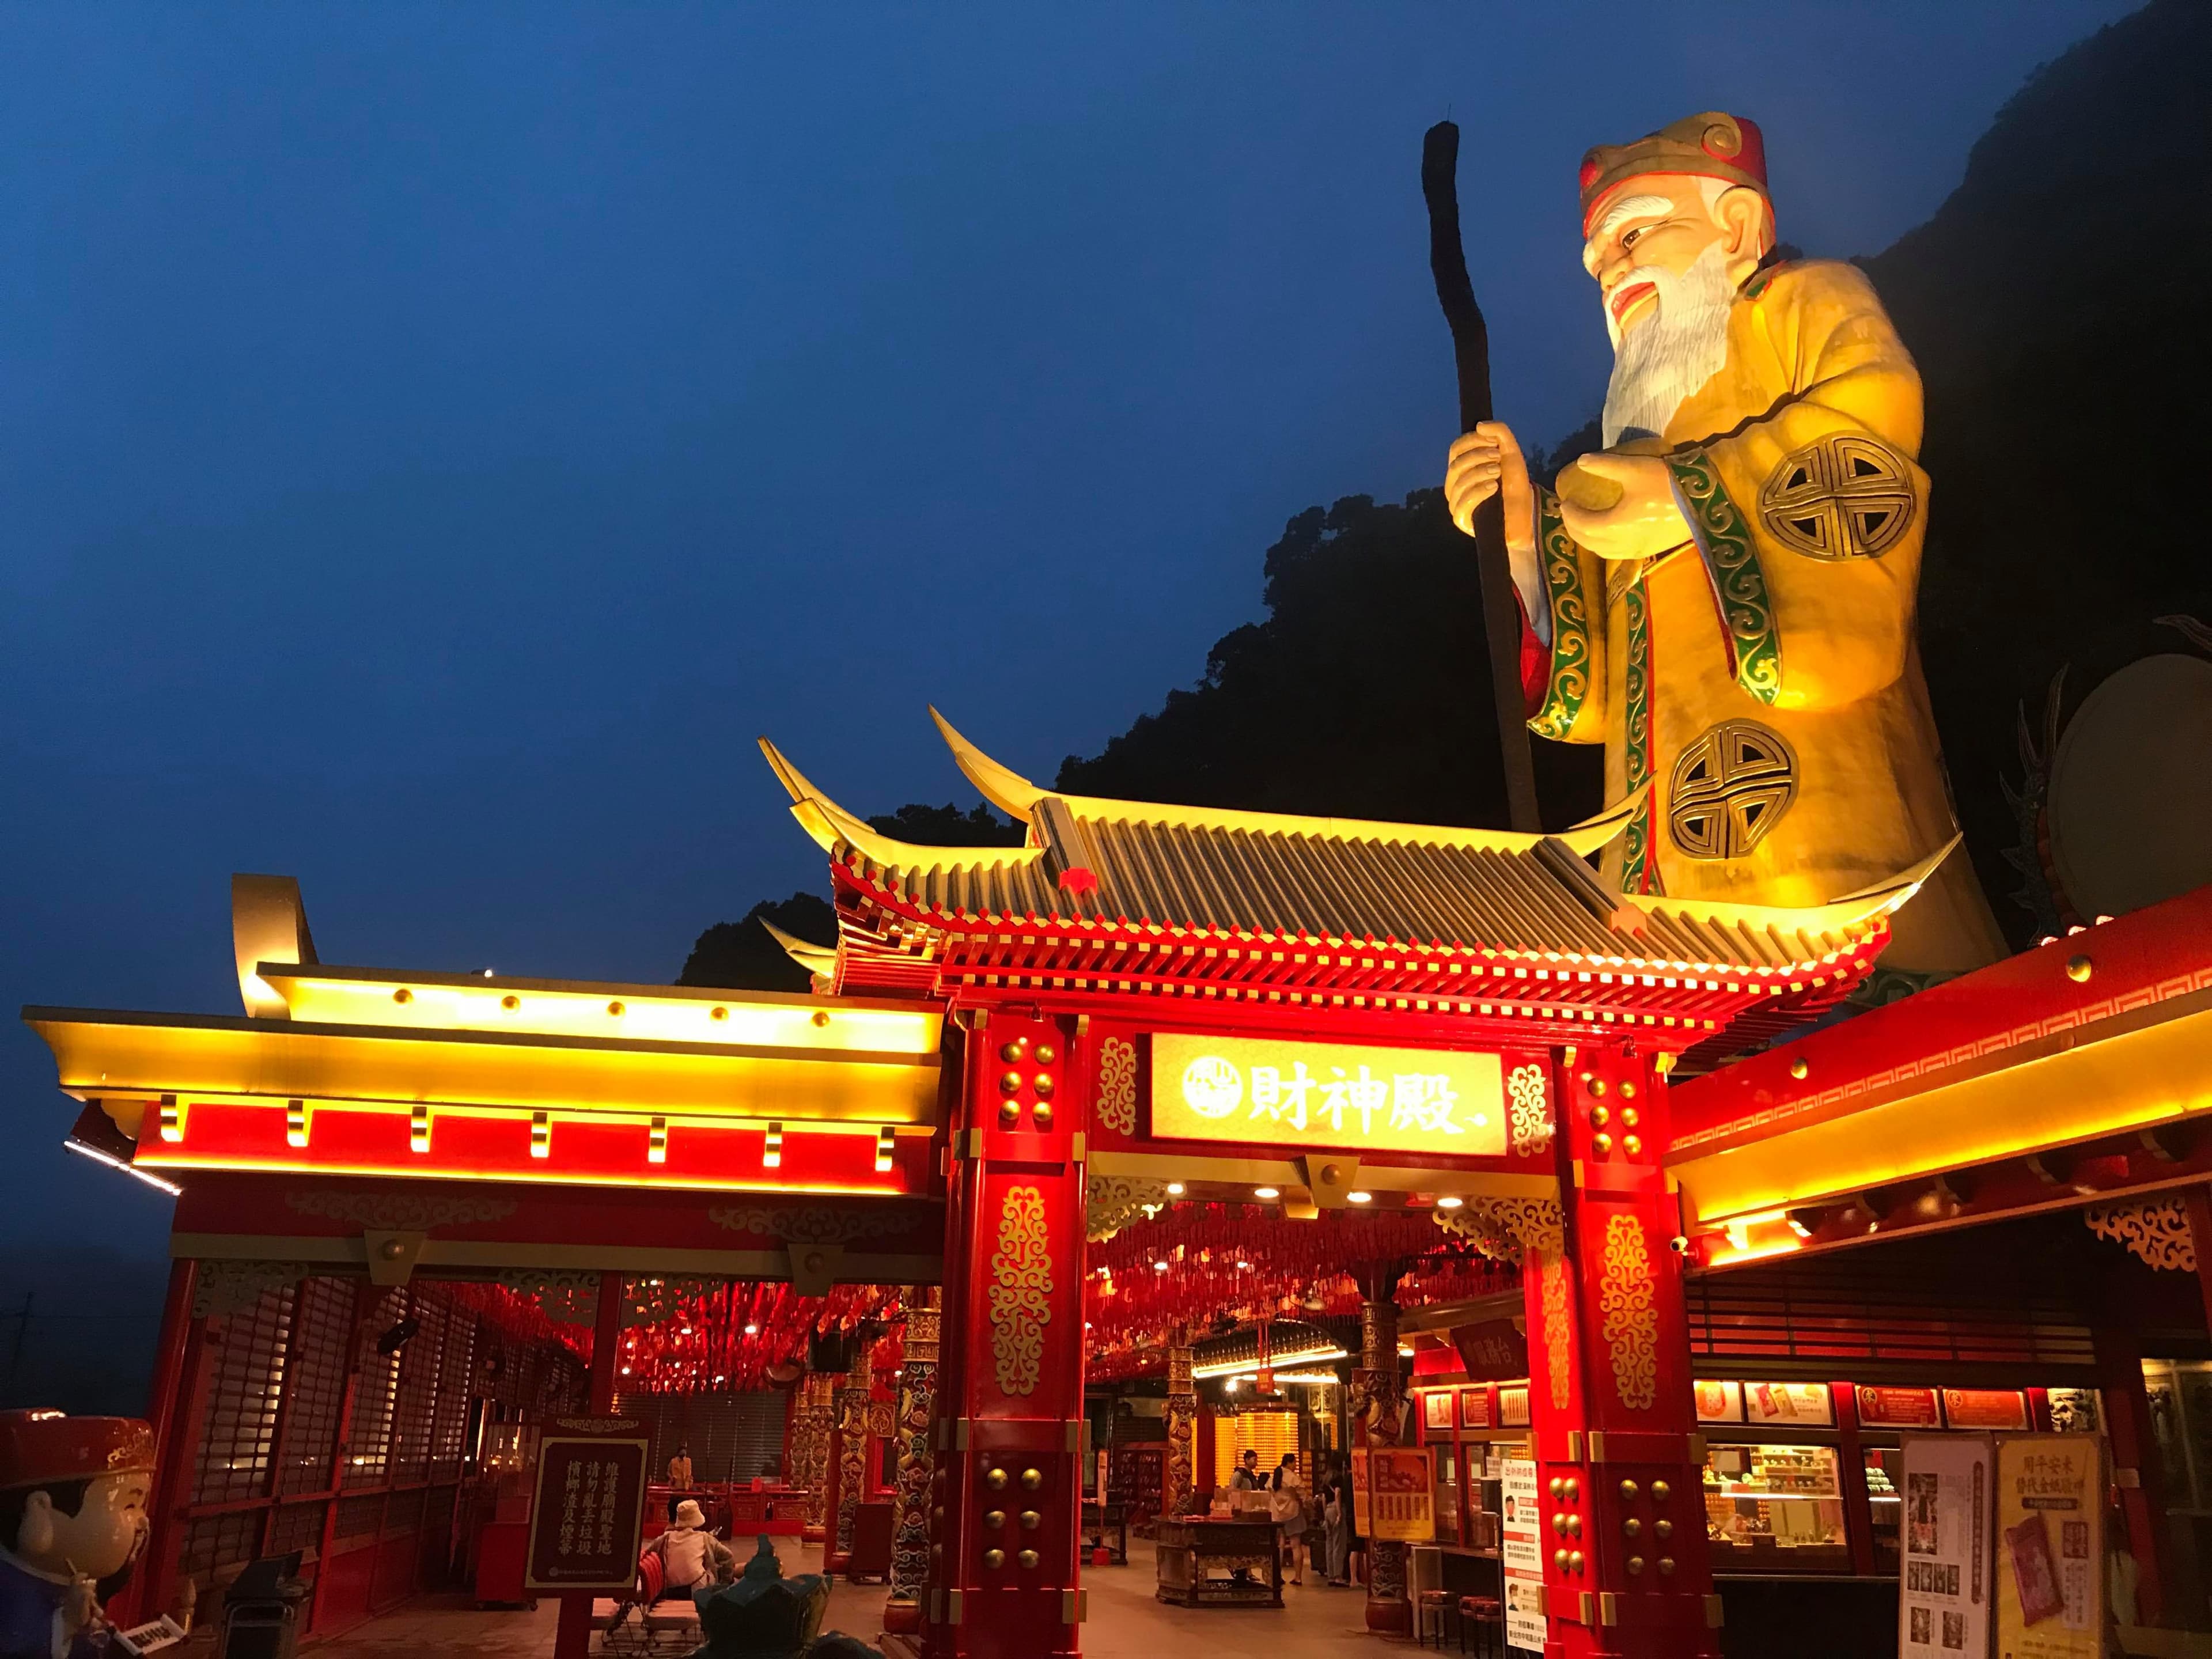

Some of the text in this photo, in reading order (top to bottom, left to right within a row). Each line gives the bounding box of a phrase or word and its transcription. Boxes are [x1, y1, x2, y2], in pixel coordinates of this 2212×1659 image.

[1248, 1060, 1465, 1134] 財神殿
[577, 1461, 600, 1555] 請勿亂丟垃圾
